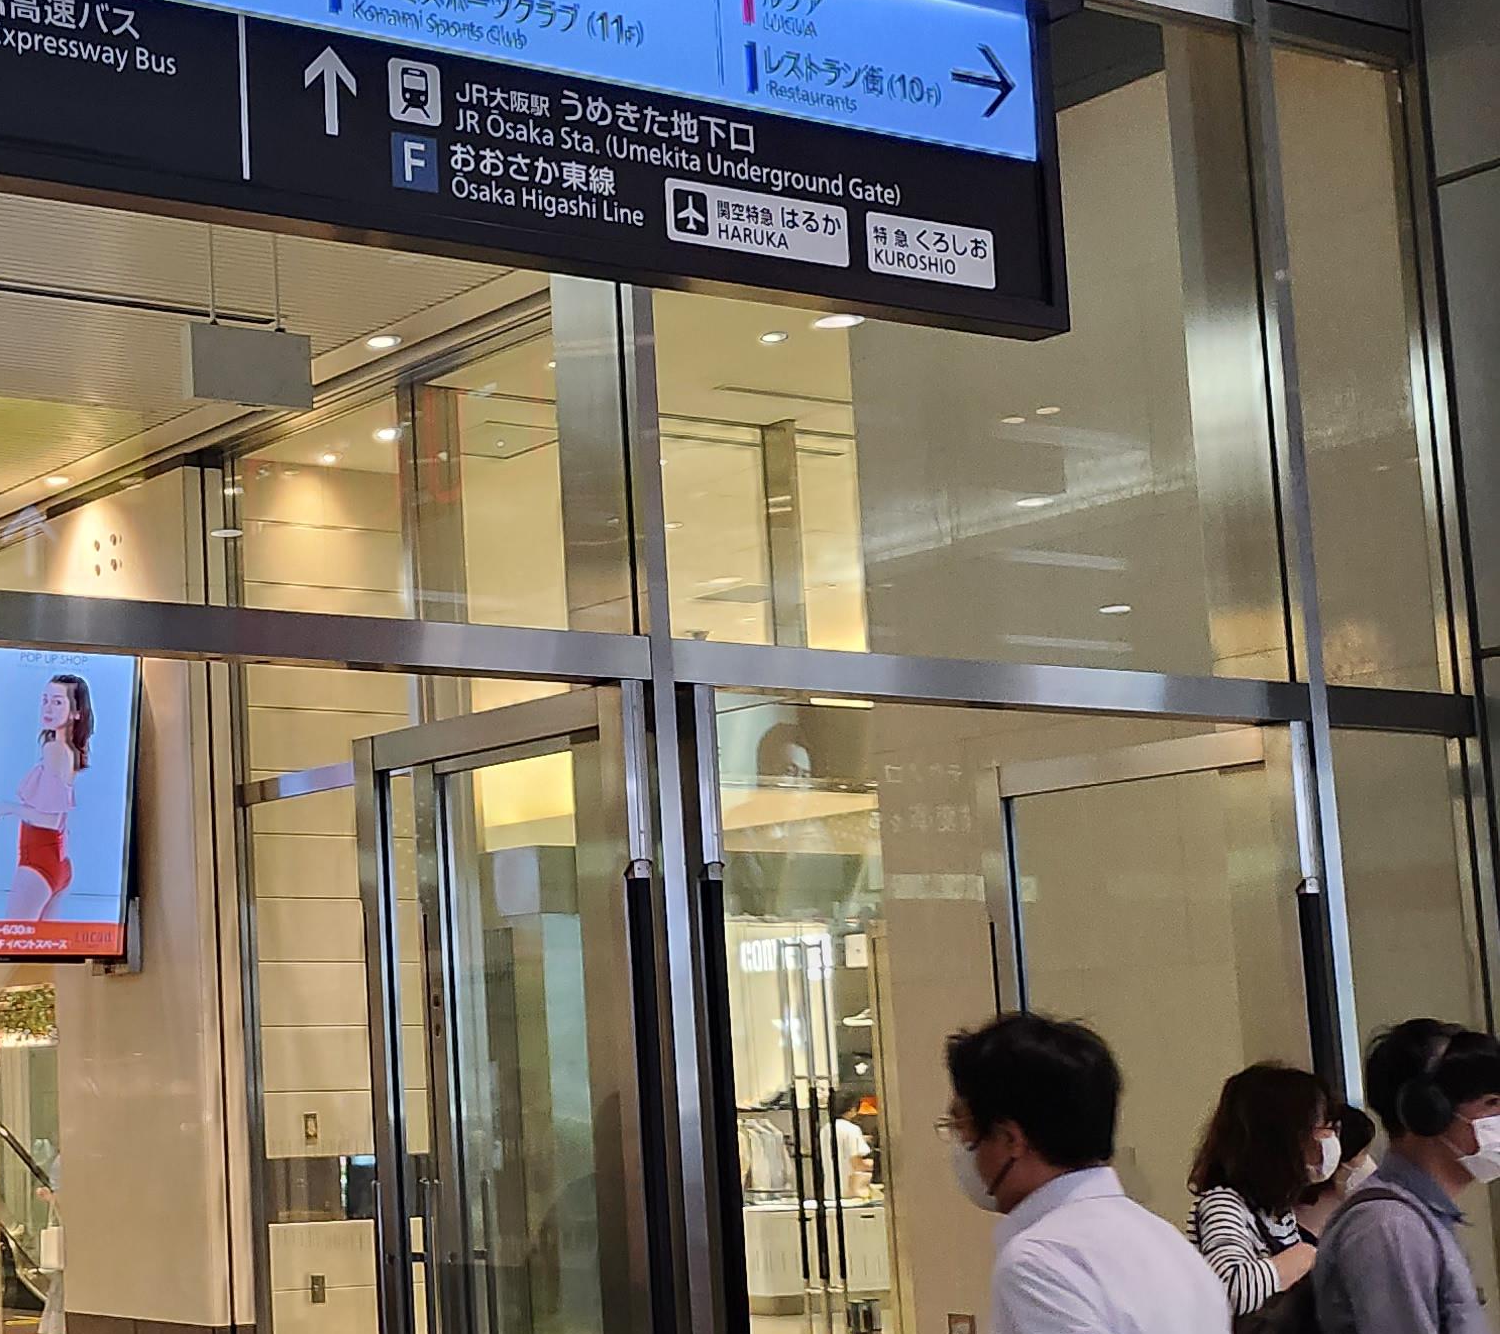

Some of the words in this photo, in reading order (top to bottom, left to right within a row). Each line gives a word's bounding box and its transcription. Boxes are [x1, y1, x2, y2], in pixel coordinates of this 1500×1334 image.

[426, 14, 484, 42] Sports
[486, 23, 527, 50] Club
[763, 13, 818, 38] LUCUA
[136, 47, 177, 75] Bus
[766, 80, 857, 112] Restaurants
[455, 82, 550, 117] JR大阪駅
[560, 89, 755, 154] うめきた地下口
[403, 140, 426, 182] F
[450, 142, 616, 197] おおさか東線
[456, 109, 480, 134] JR
[486, 110, 554, 147] Ōsaka
[560, 127, 601, 156] Sta.
[605, 134, 701, 172] (Umekita
[707, 151, 844, 197] Underground
[849, 178, 901, 207] Gate)
[451, 172, 516, 207] Ōsaka
[522, 189, 597, 220] Higashi
[602, 200, 645, 226] Line
[716, 200, 773, 227] 関空特急
[780, 206, 842, 236] はるか
[718, 223, 789, 250] HARUKA
[915, 229, 988, 260] くろしお
[874, 248, 957, 276] KUROSHIO
